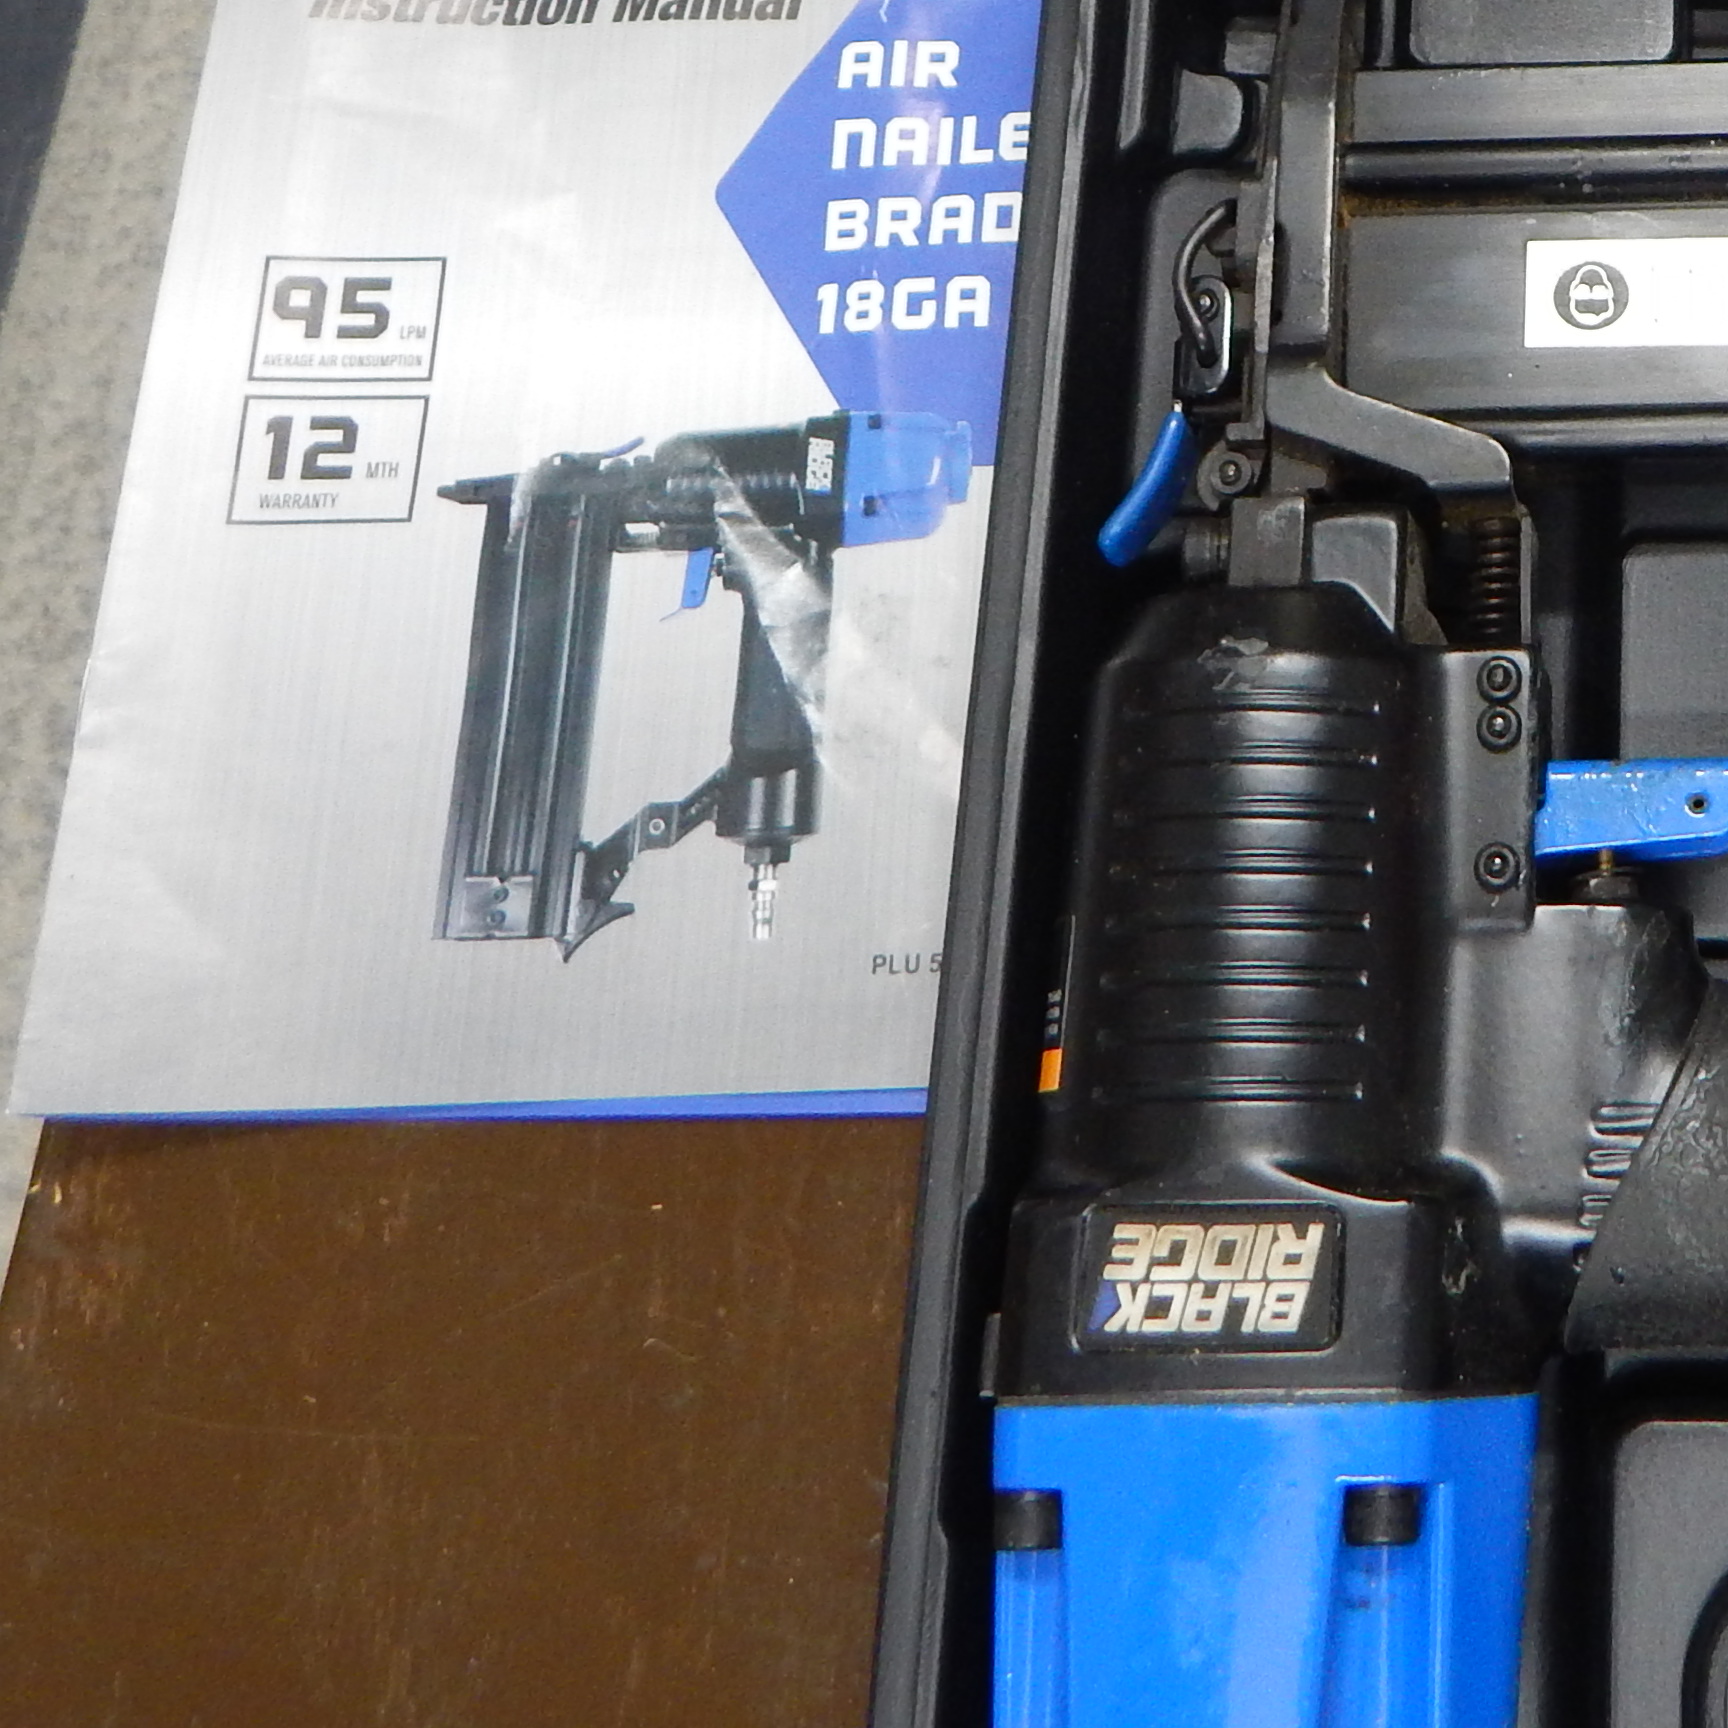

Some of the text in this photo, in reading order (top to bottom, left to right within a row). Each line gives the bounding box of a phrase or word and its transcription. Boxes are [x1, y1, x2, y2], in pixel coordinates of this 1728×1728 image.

[837, 40, 960, 89] AIR
[824, 191, 1023, 252] BRAD
[272, 275, 427, 341] 95 LPM
[817, 274, 991, 334] 18GA
[262, 353, 423, 368] AVERAGE AIR CONSUMPTION
[265, 415, 399, 480] 12 MTH
[259, 492, 340, 509] WARRANTY
[871, 952, 920, 975] PLU
[1102, 1223, 1325, 1281] RIDGE
[1104, 1281, 1311, 1333] BLACK
